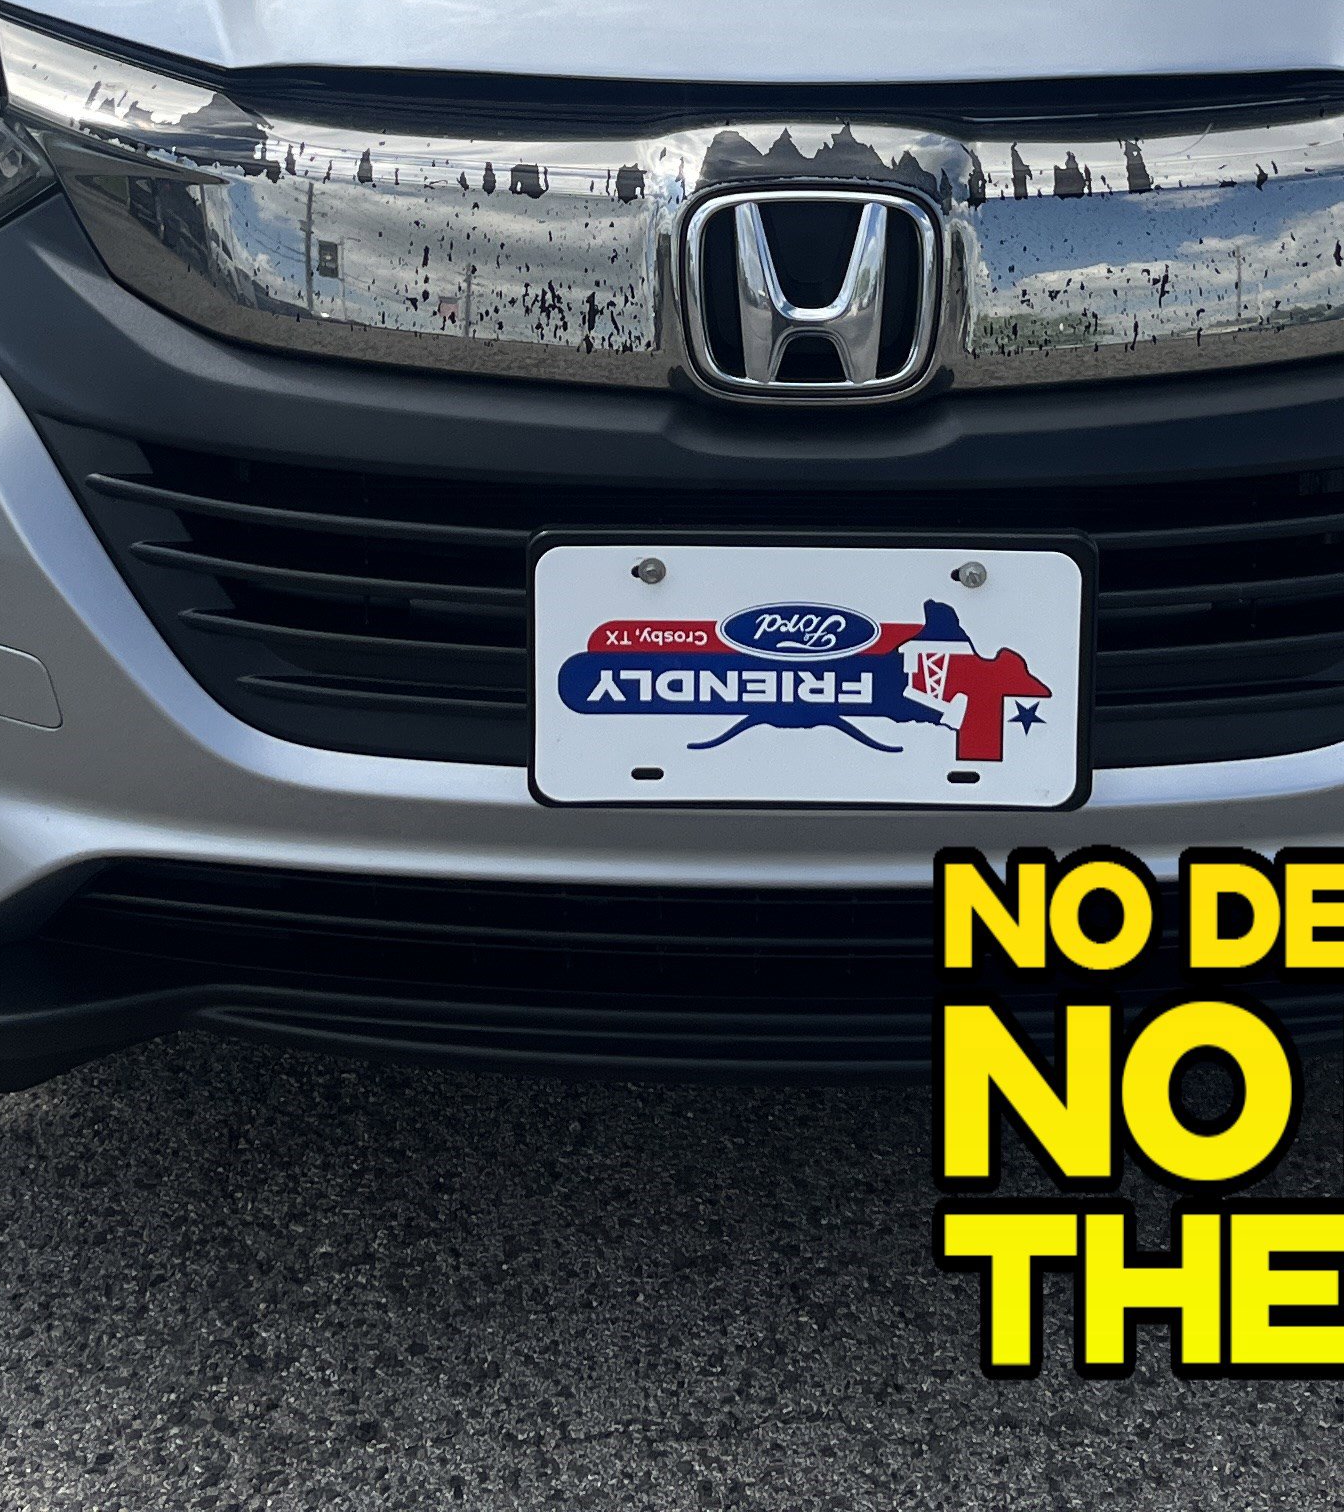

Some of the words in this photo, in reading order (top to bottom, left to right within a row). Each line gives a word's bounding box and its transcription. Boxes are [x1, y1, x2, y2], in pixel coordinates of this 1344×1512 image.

[606, 630, 632, 645] TX
[635, 626, 708, 646] Crosby,
[755, 612, 847, 650] Ford
[586, 669, 873, 703] FRIENDLY
